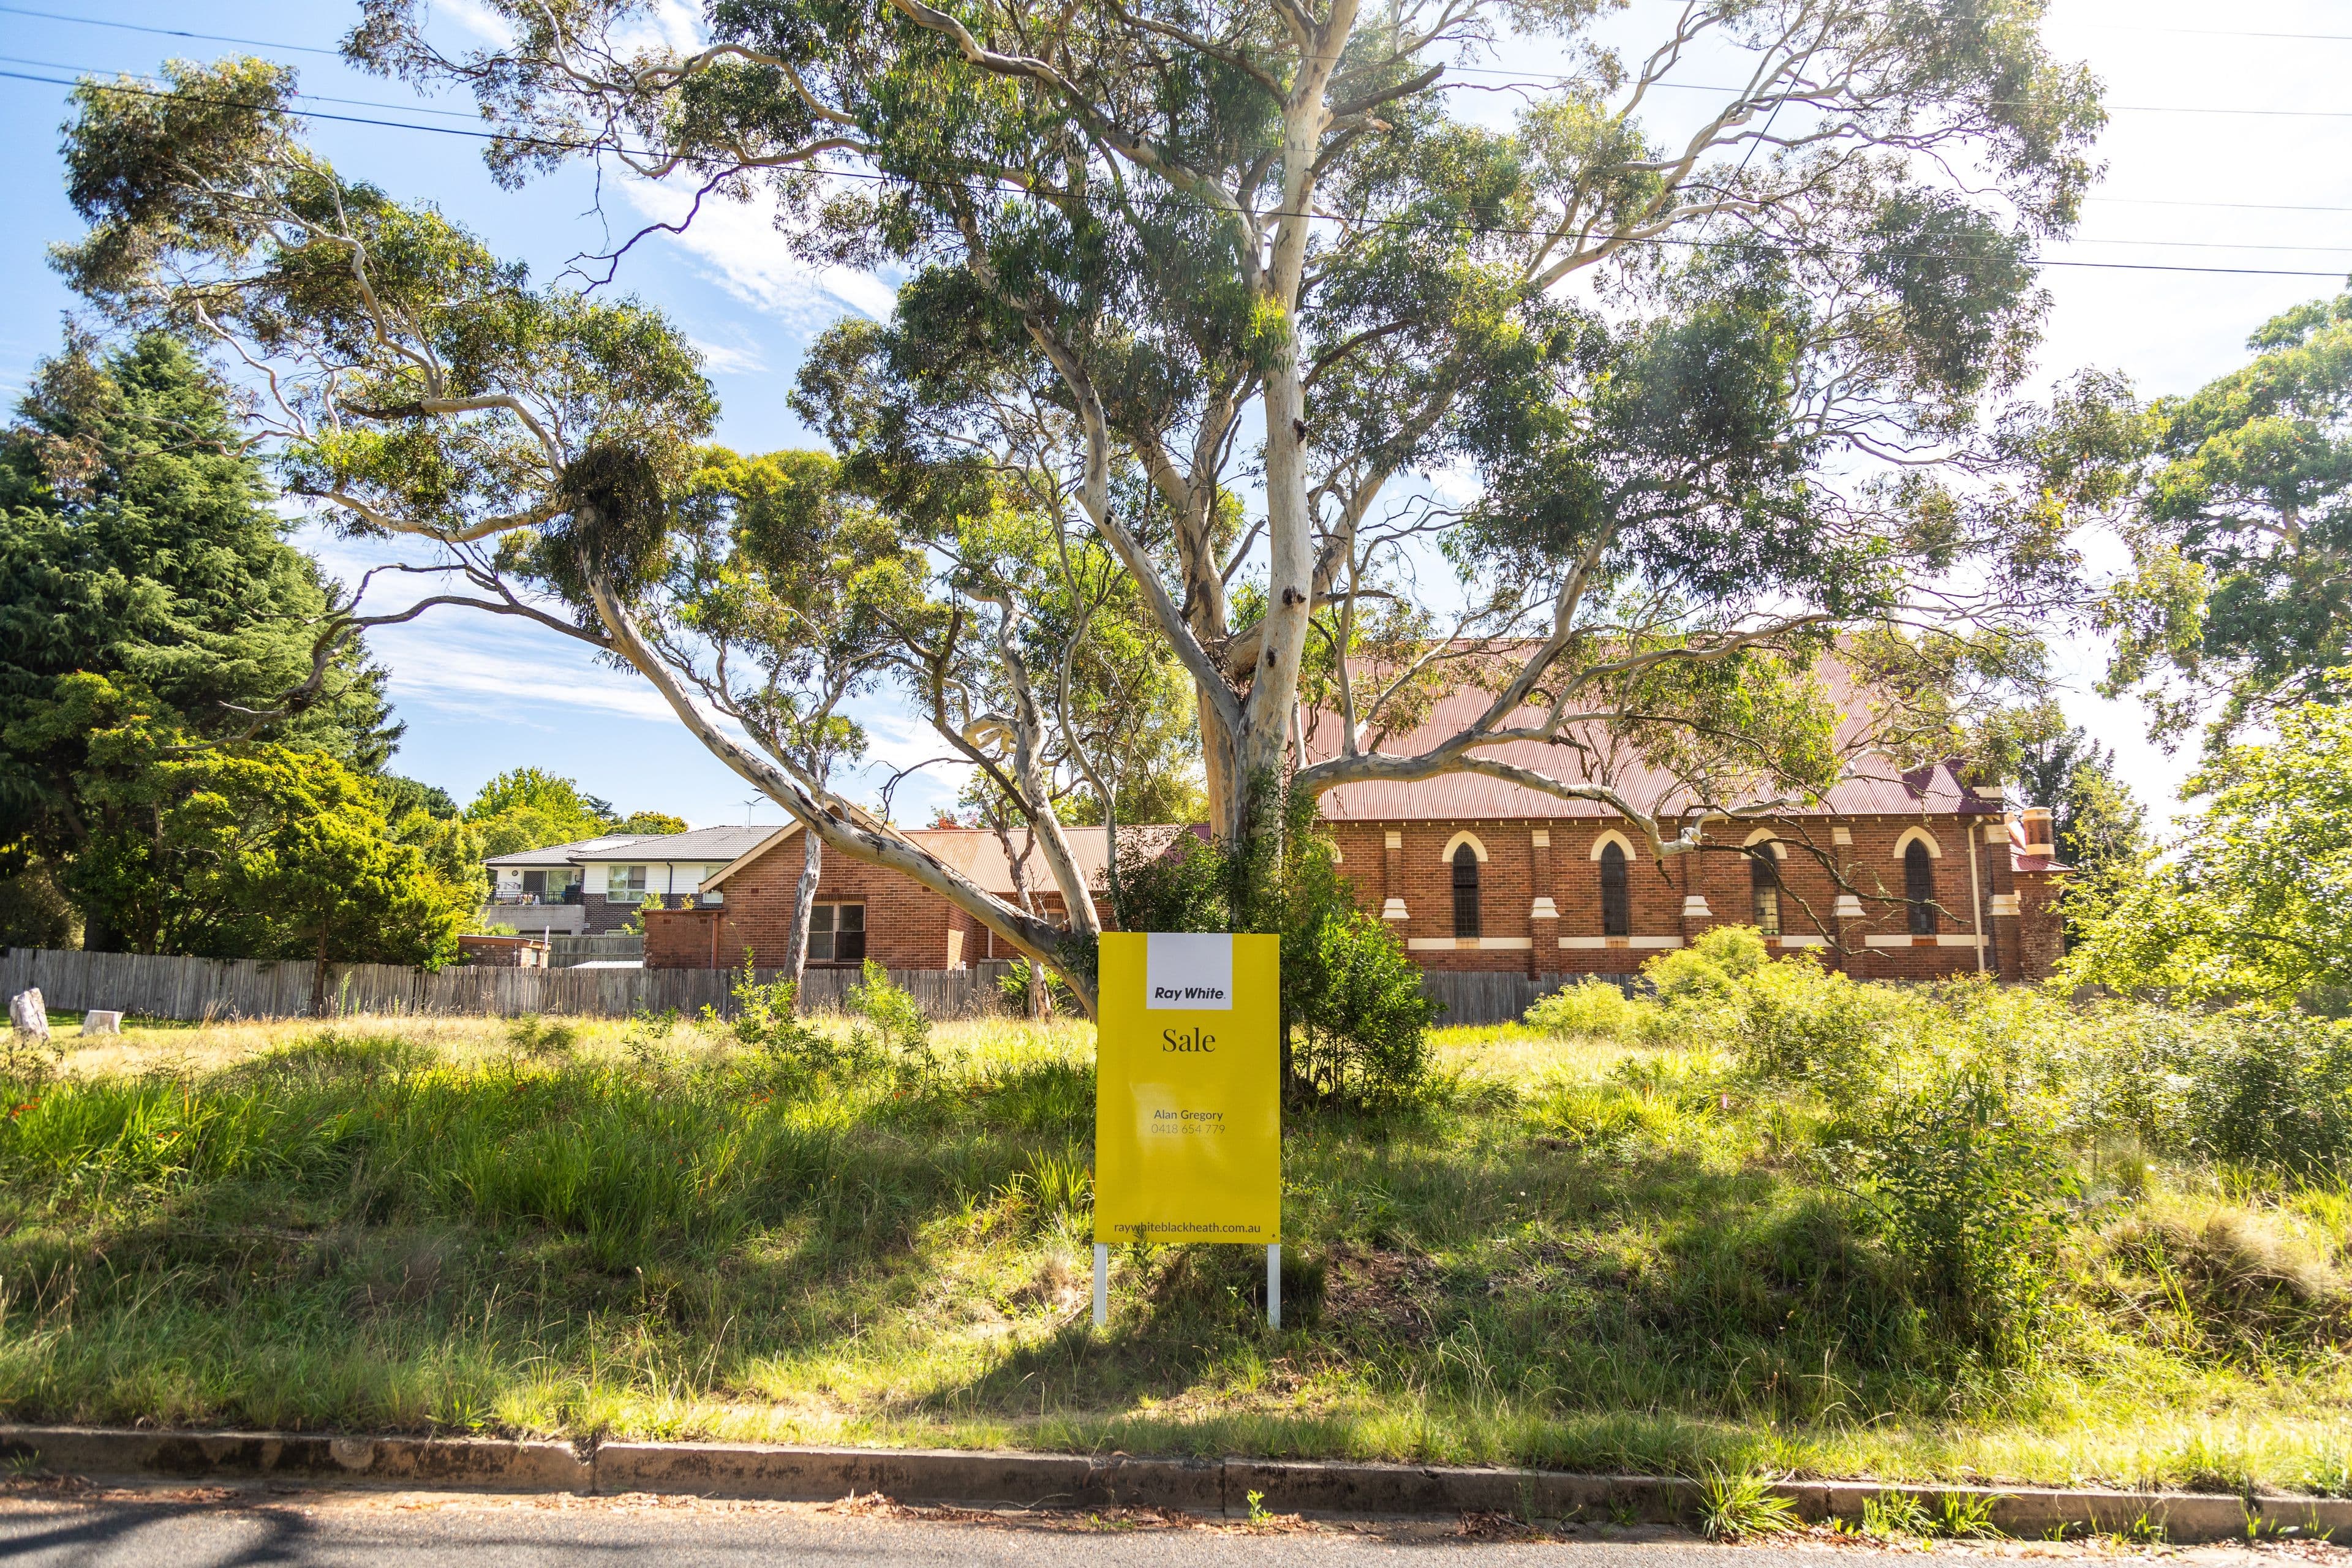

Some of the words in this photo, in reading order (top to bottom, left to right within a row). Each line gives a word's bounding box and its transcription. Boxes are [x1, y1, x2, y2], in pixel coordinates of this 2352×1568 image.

[1155, 987, 1182, 1001] Ray
[1163, 1027, 1216, 1052] Sale
[1154, 1110, 1177, 1120] Alan
[1180, 1110, 1223, 1121] Gregory
[1151, 1124, 1178, 1134] 0418
[1182, 1124, 1201, 1134] 654
[1205, 1124, 1226, 1134] 779
